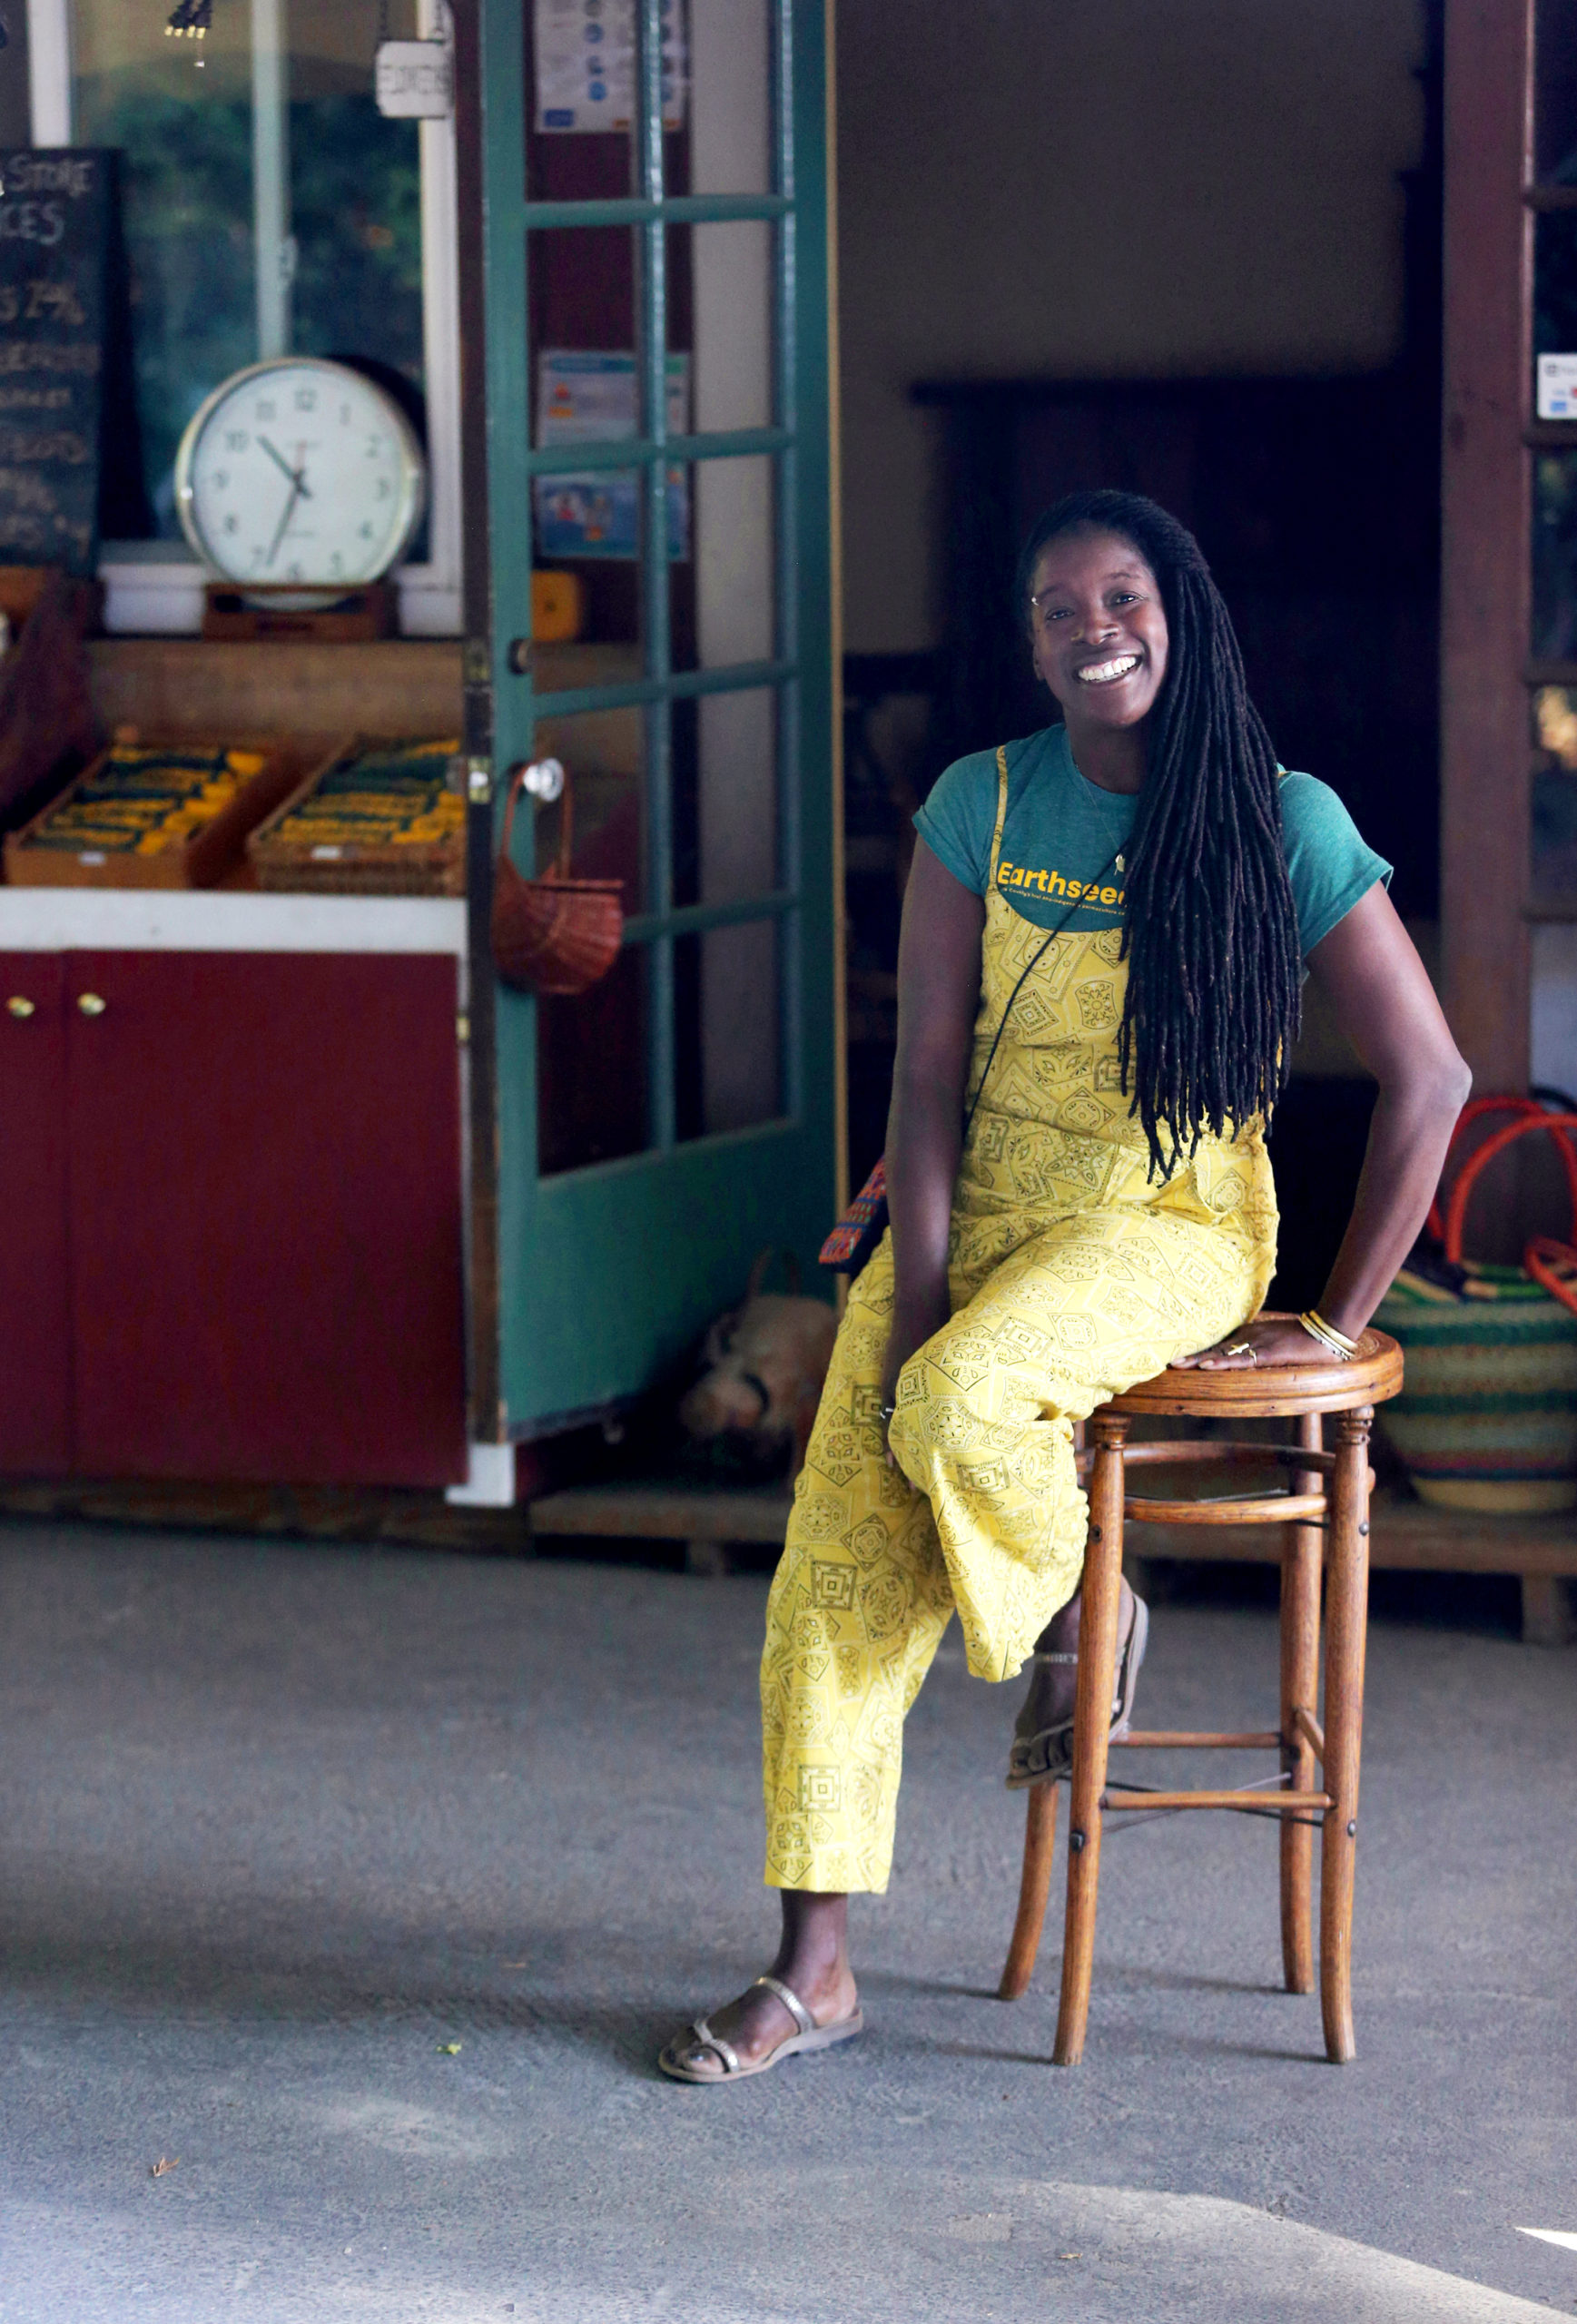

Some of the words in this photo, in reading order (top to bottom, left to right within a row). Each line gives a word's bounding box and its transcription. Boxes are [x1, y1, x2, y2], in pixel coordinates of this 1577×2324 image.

[295, 389, 316, 411] 12
[225, 430, 250, 451] 10
[365, 435, 383, 458] 2
